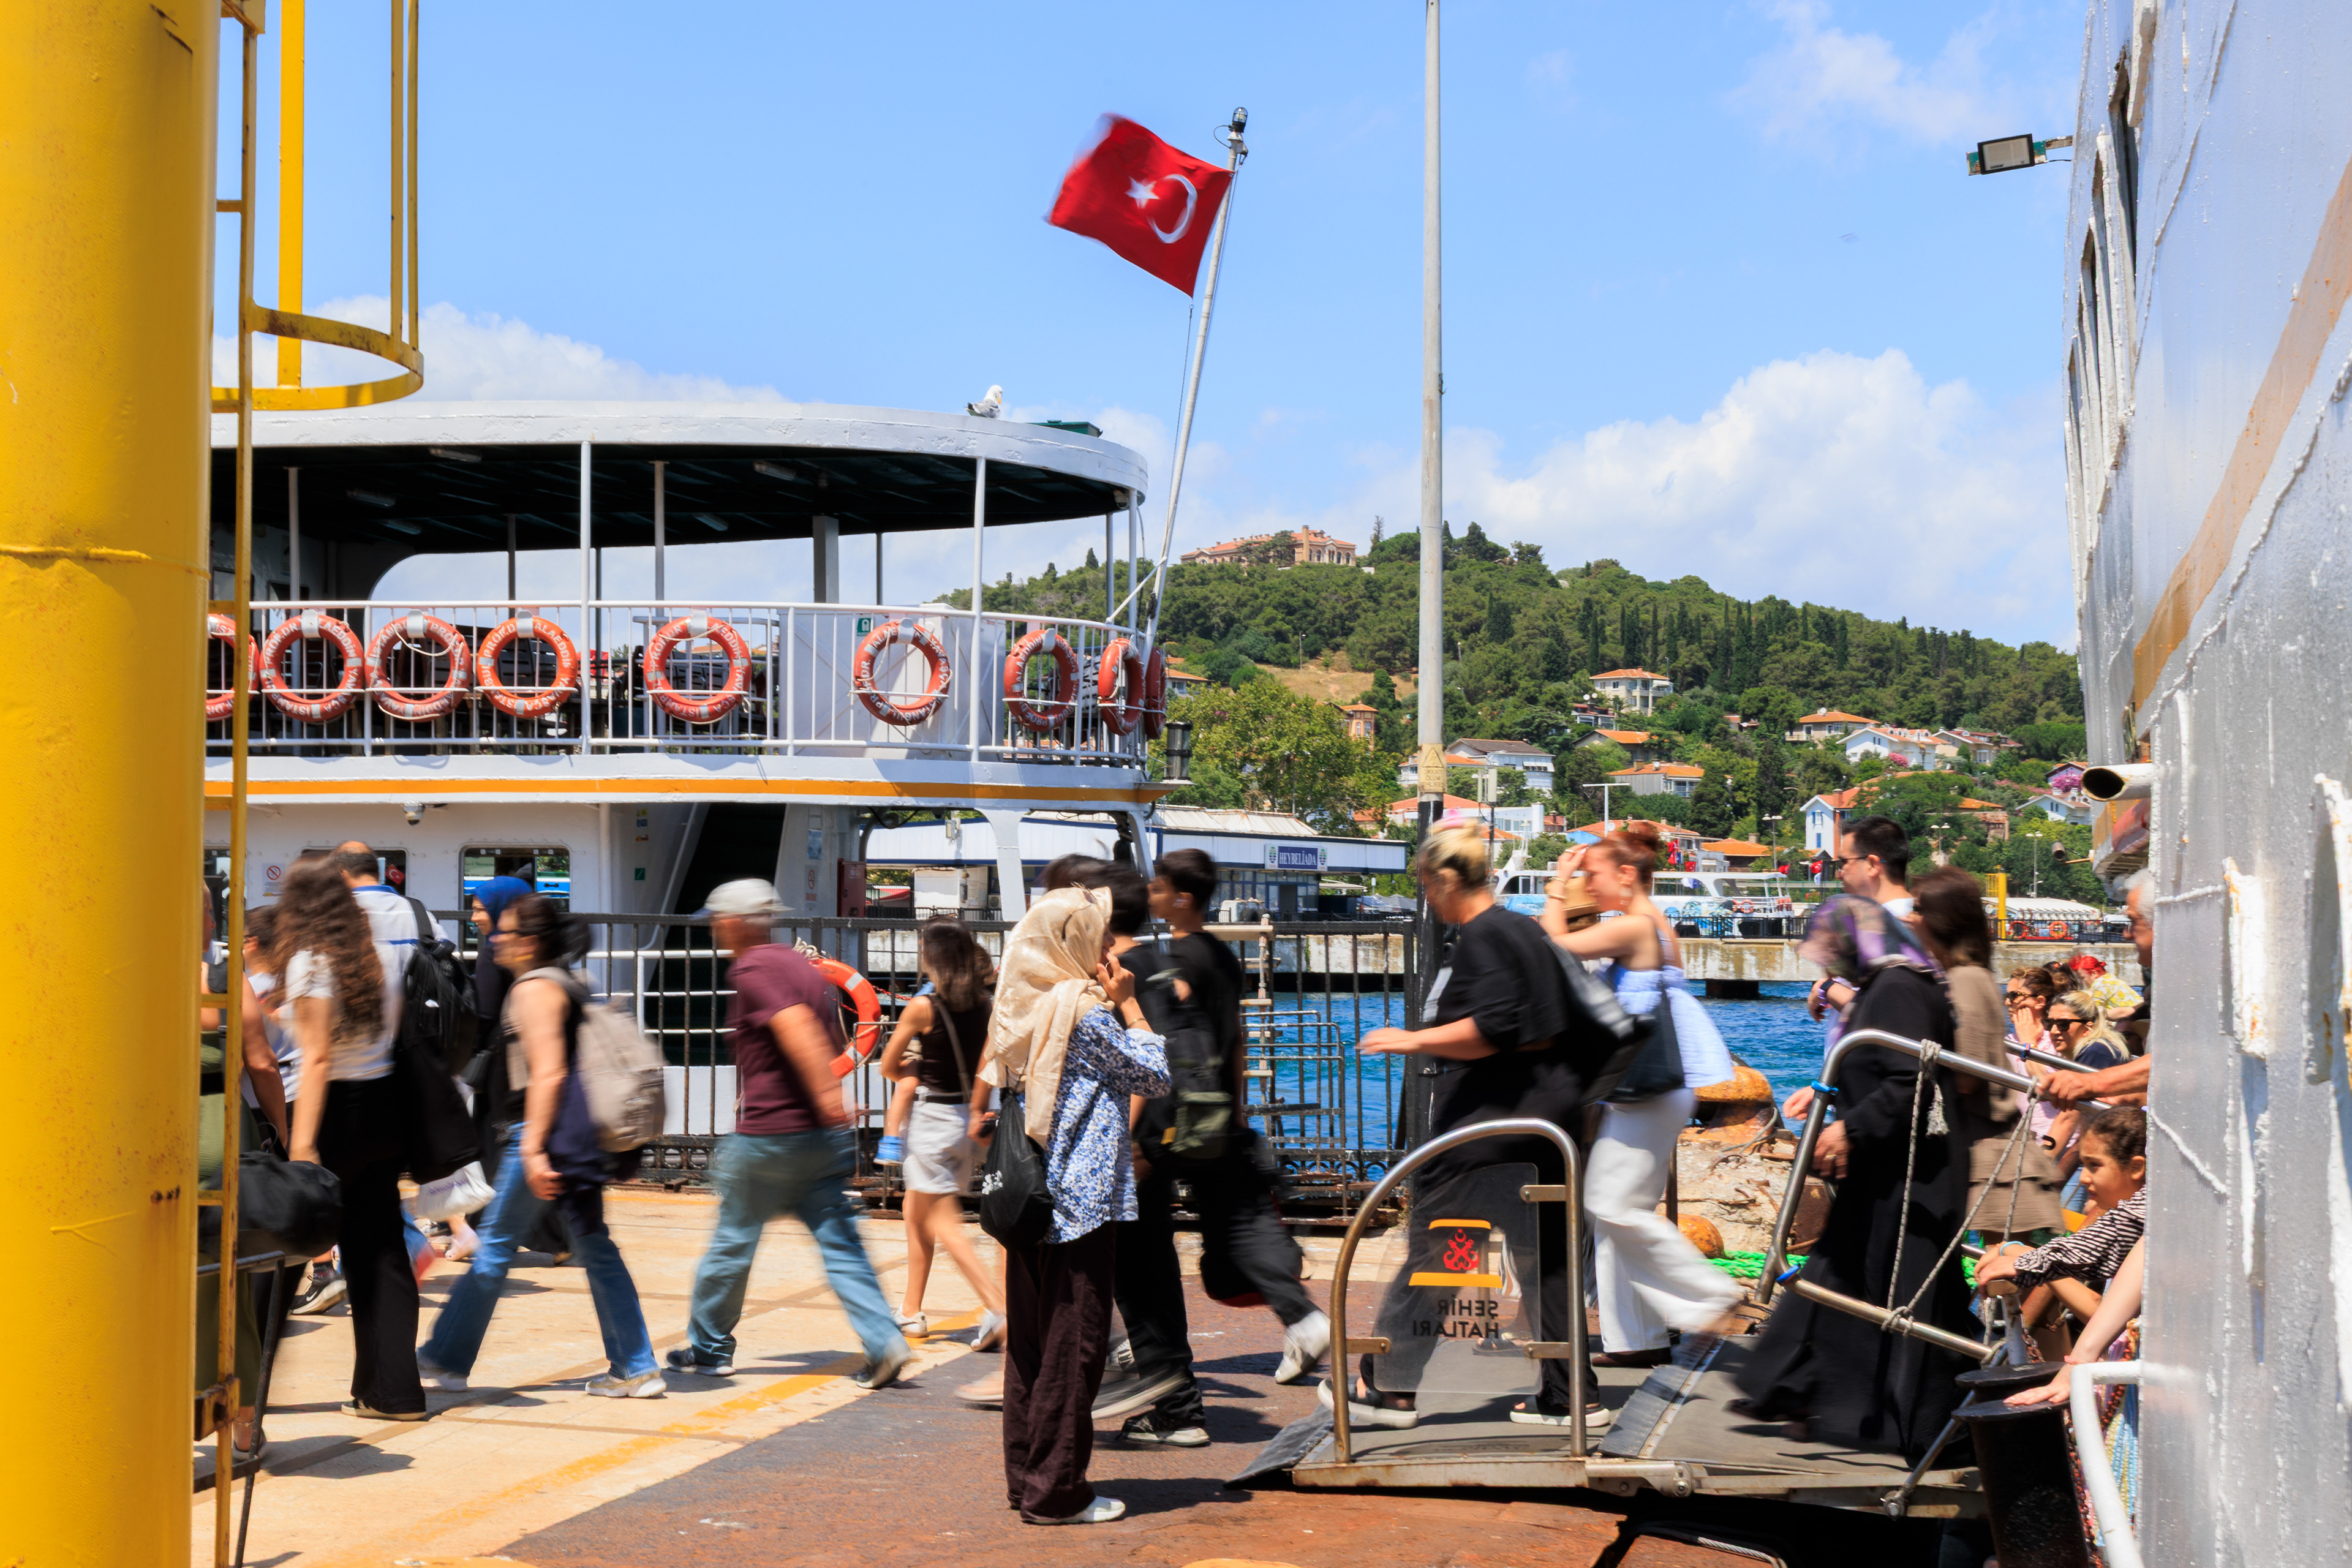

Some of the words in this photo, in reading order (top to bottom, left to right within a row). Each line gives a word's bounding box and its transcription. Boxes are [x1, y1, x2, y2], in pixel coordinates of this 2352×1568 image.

[318, 620, 357, 658] LAEDDİN
[534, 622, 573, 669] ALAEDDİN
[1279, 850, 1316, 865] HEYBELİADA
